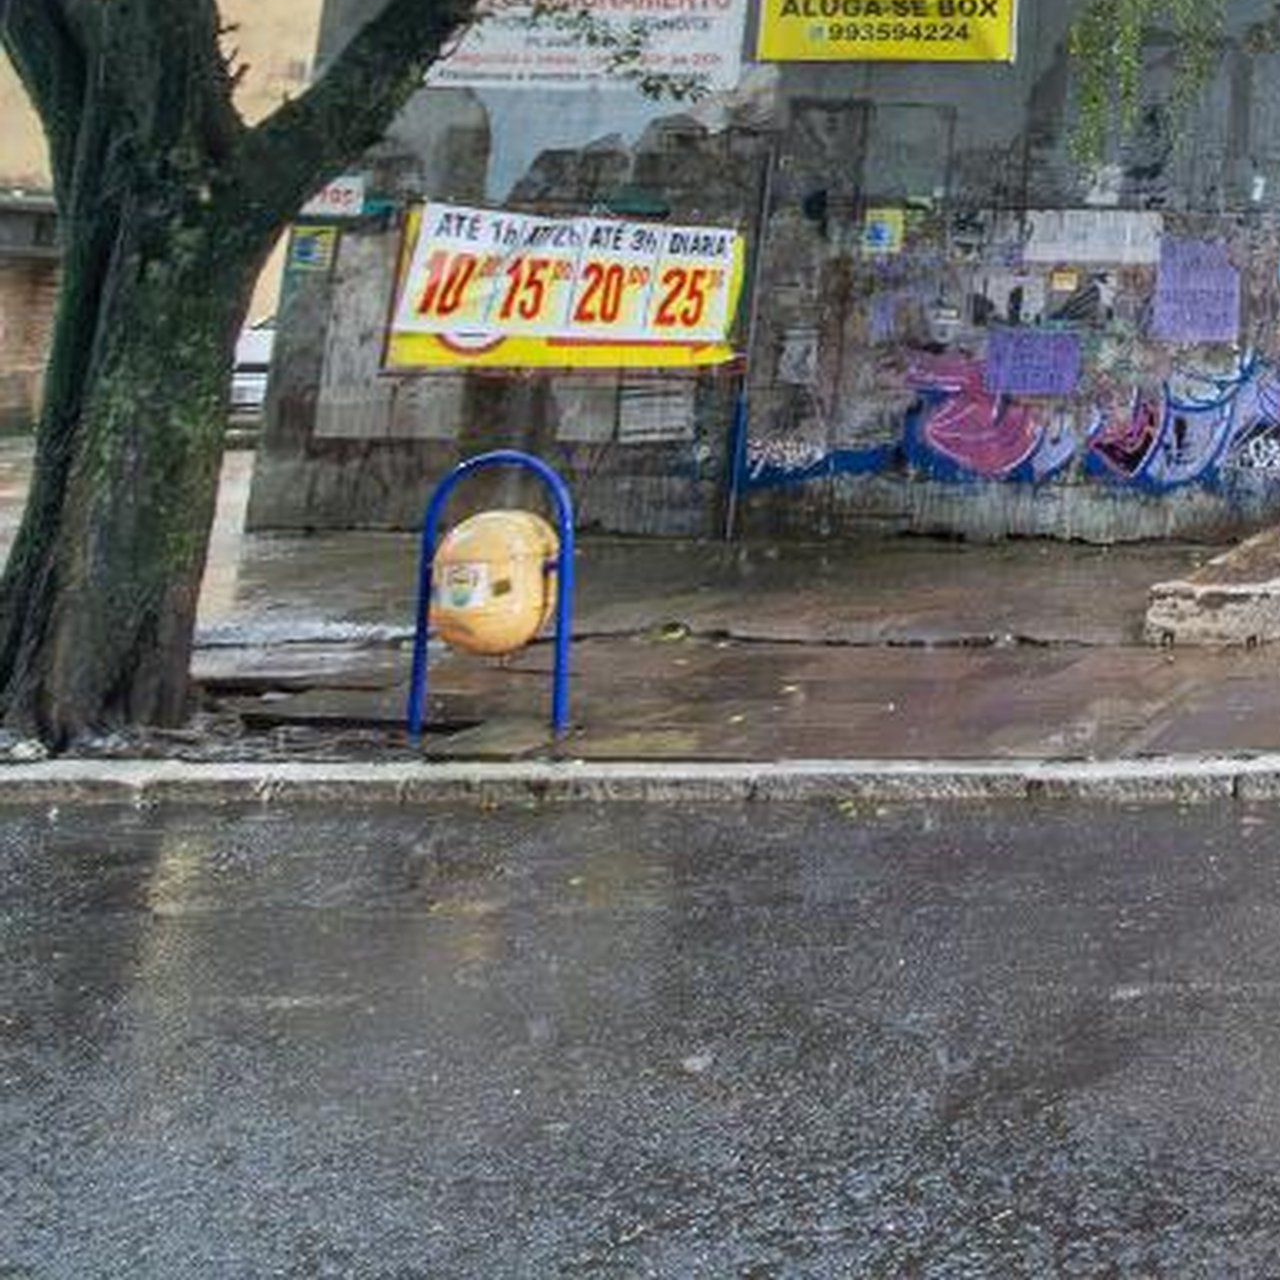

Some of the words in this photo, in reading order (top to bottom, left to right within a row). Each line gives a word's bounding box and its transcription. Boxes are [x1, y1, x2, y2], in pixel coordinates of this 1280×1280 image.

[828, 22, 970, 41] 993594224
[418, 252, 477, 315] 10
[500, 256, 550, 321] 15
[573, 263, 624, 323] 20
[653, 267, 707, 327] 25
